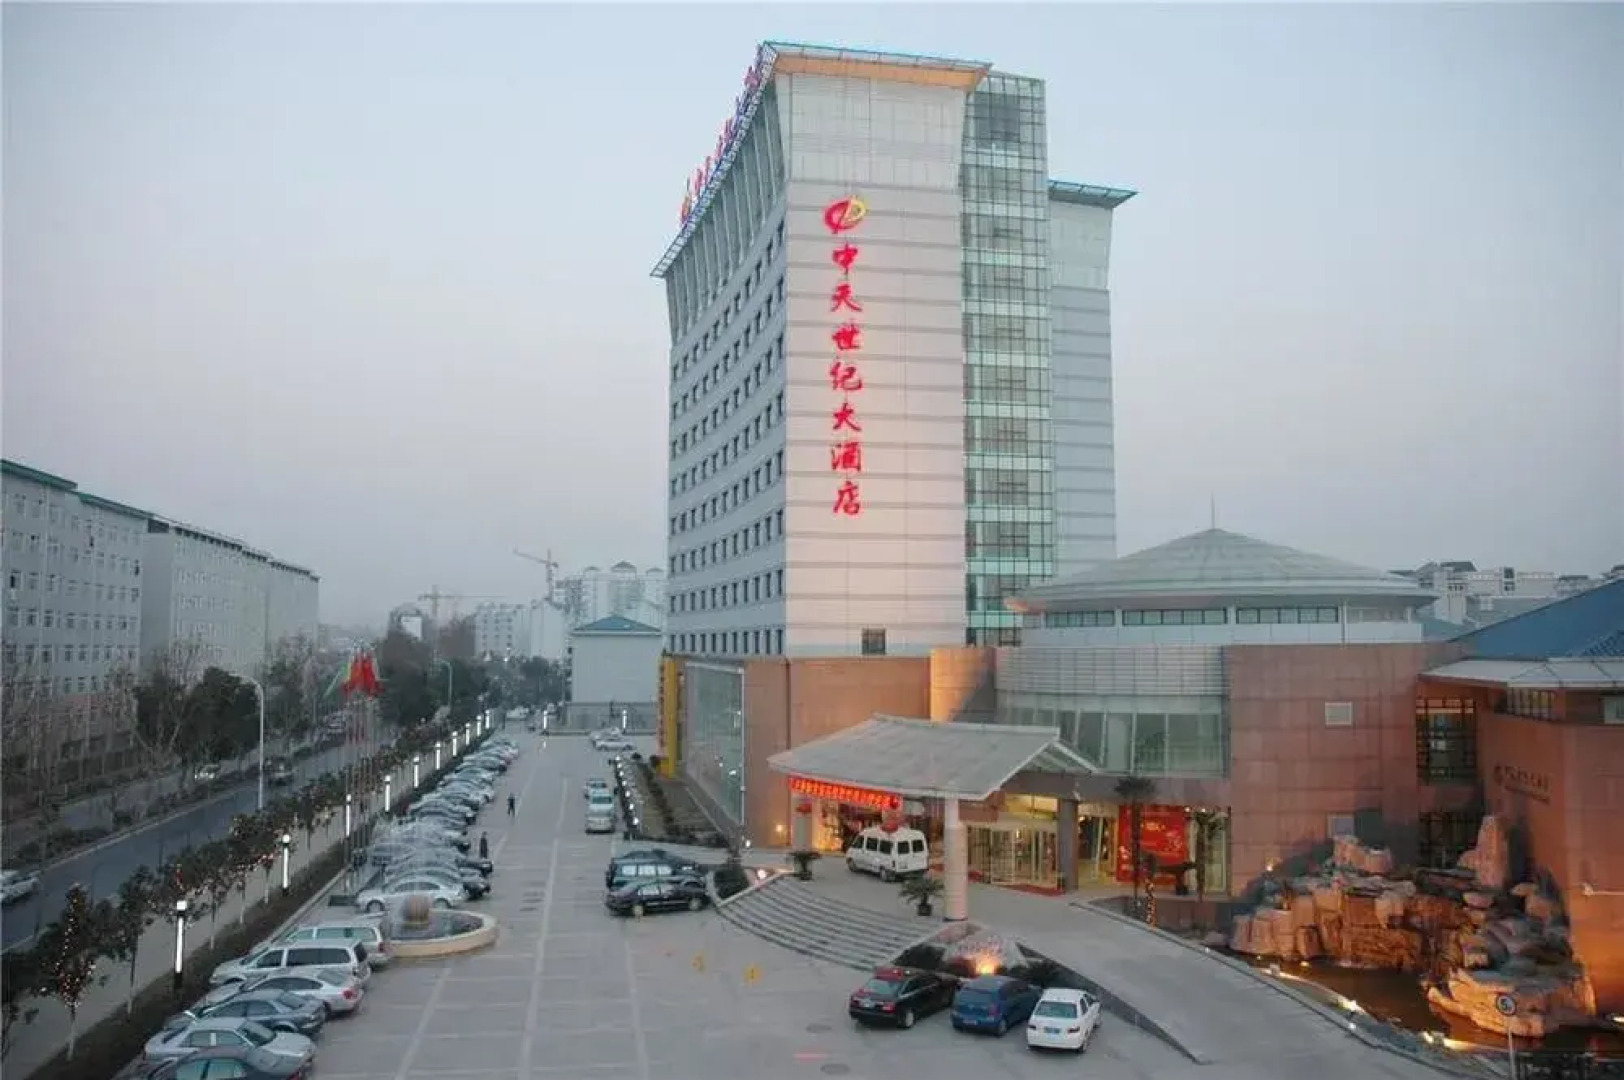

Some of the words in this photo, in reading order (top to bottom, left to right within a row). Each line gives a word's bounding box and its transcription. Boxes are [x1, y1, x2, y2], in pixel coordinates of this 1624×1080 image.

[829, 243, 864, 517] 中天世纪大酒店
